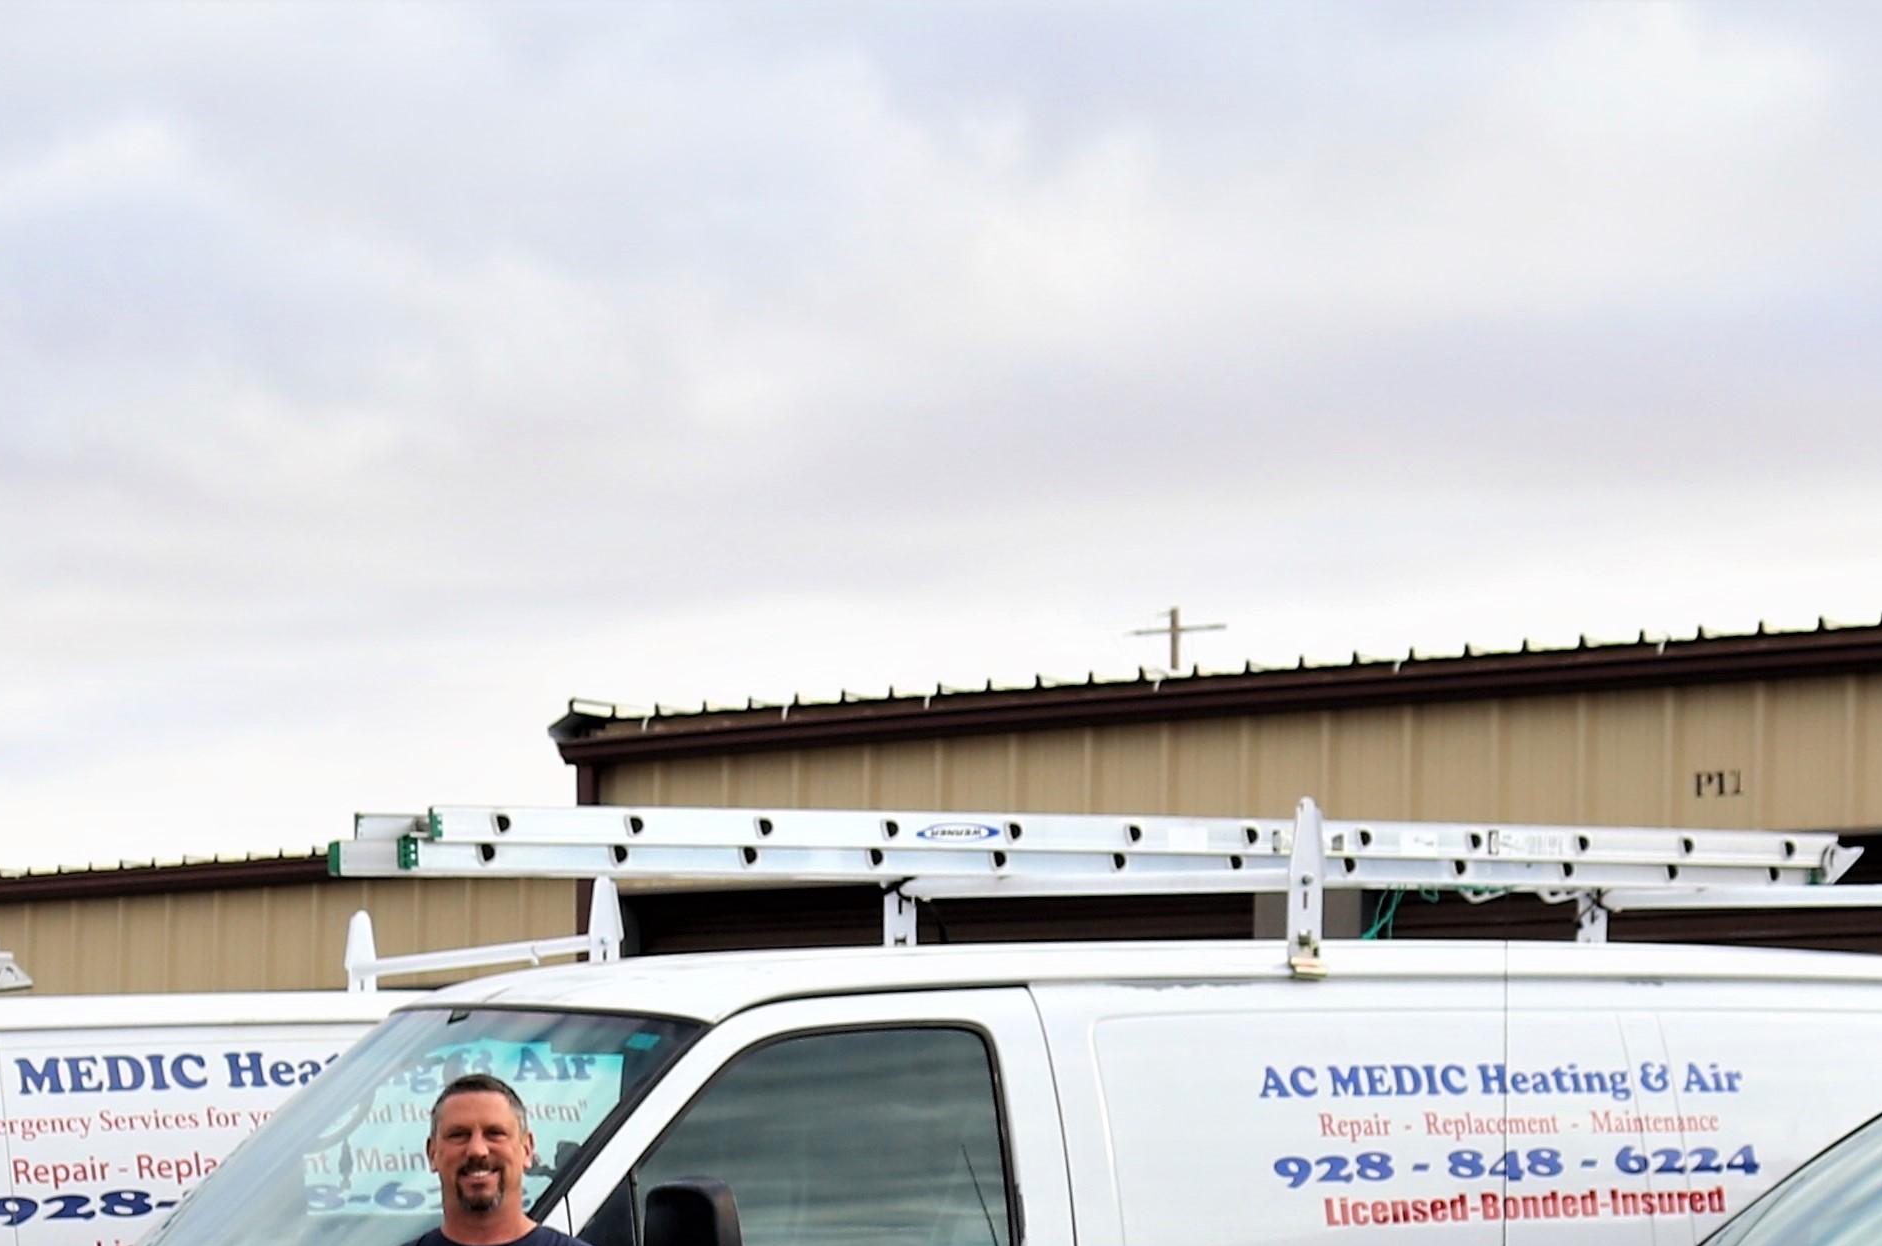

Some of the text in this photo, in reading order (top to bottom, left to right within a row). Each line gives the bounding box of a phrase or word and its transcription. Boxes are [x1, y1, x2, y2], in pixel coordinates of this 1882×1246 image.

[1695, 770, 1743, 798] P11
[15, 1054, 208, 1095] MEDIC
[513, 1046, 596, 1082] Air
[1260, 1062, 1742, 1101] AC MEDIC Heating & Air
[100, 1109, 199, 1132] Services
[206, 1106, 242, 1128] for
[1319, 1113, 1391, 1143] Repair
[1423, 1111, 1560, 1141] Replacement
[1590, 1109, 1719, 1133] Maintenance
[11, 1155, 111, 1190] Repair
[1273, 1152, 1394, 1189] 928
[1448, 1149, 1564, 1181] 848
[1615, 1145, 1760, 1176] 6224
[1323, 1186, 1726, 1227] Licensed-Bonded-Insured
